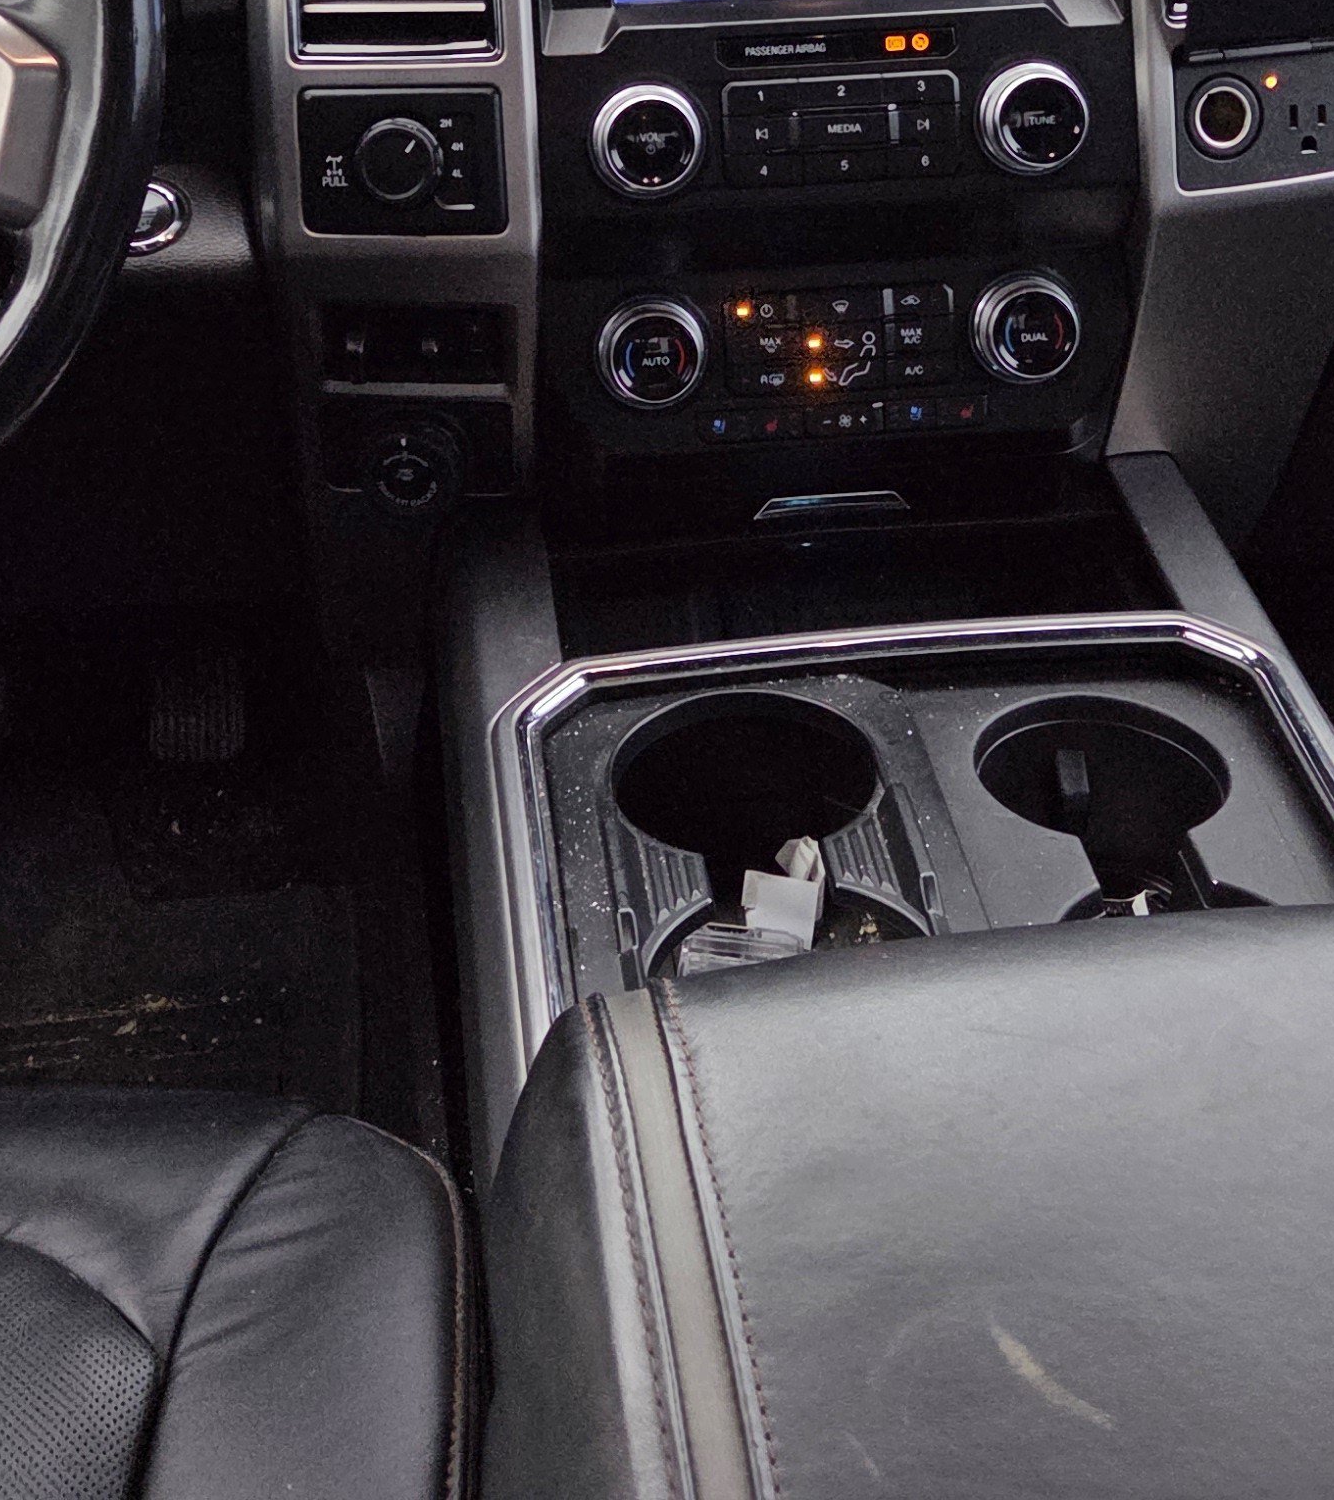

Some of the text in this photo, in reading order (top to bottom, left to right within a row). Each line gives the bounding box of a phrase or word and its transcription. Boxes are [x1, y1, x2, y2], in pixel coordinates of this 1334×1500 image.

[744, 41, 827, 59] PASSENGER AIRBAG
[836, 84, 846, 97] 2
[917, 79, 926, 92] 3
[757, 90, 765, 102] 1
[439, 118, 453, 128] 2H
[1028, 114, 1056, 126] TUNE
[826, 122, 863, 135] MEDIA
[451, 142, 464, 151] 4H
[840, 159, 849, 172] 5
[921, 154, 930, 168] 6
[759, 164, 769, 177] 4
[321, 176, 349, 187] PULL
[899, 327, 923, 338] MAX
[1021, 331, 1049, 343] DUAL
[759, 337, 782, 348] MAX
[903, 334, 922, 345] A/C
[641, 356, 671, 368] AUTO
[903, 364, 924, 376] A/C
